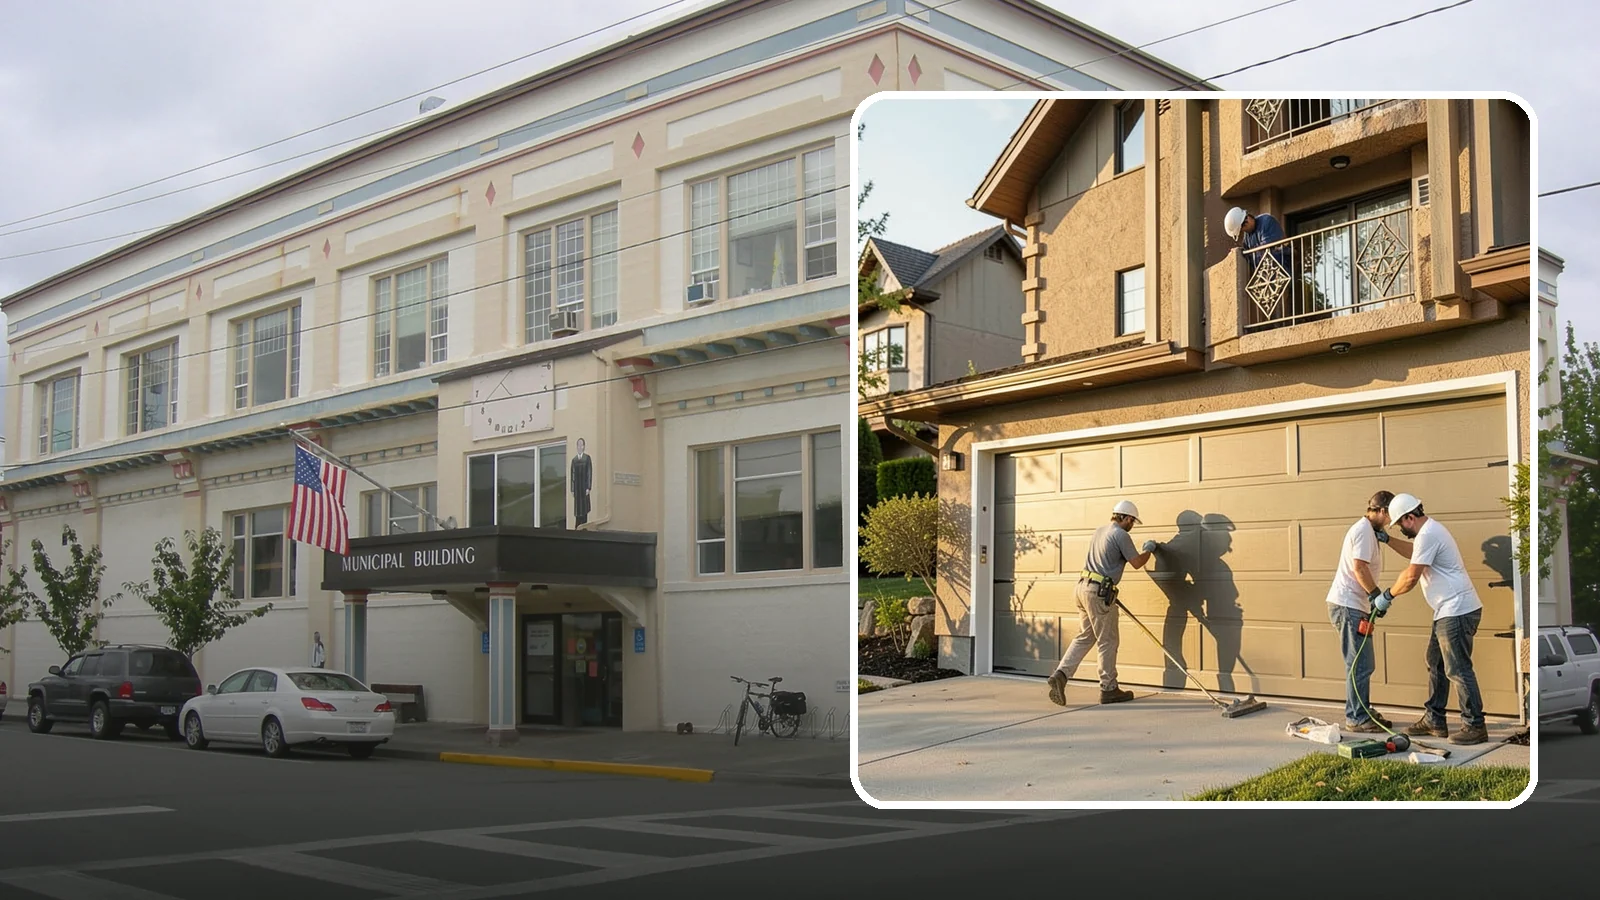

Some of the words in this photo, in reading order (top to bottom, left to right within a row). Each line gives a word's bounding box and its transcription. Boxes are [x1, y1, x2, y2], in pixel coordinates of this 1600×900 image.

[481, 407, 485, 415] 8
[488, 418, 492, 426] 9
[495, 424, 500, 432] 10
[529, 414, 533, 422] 3
[536, 402, 540, 410] 4
[342, 552, 405, 572] MUNICIPAL
[414, 546, 475, 567] BUILDING
